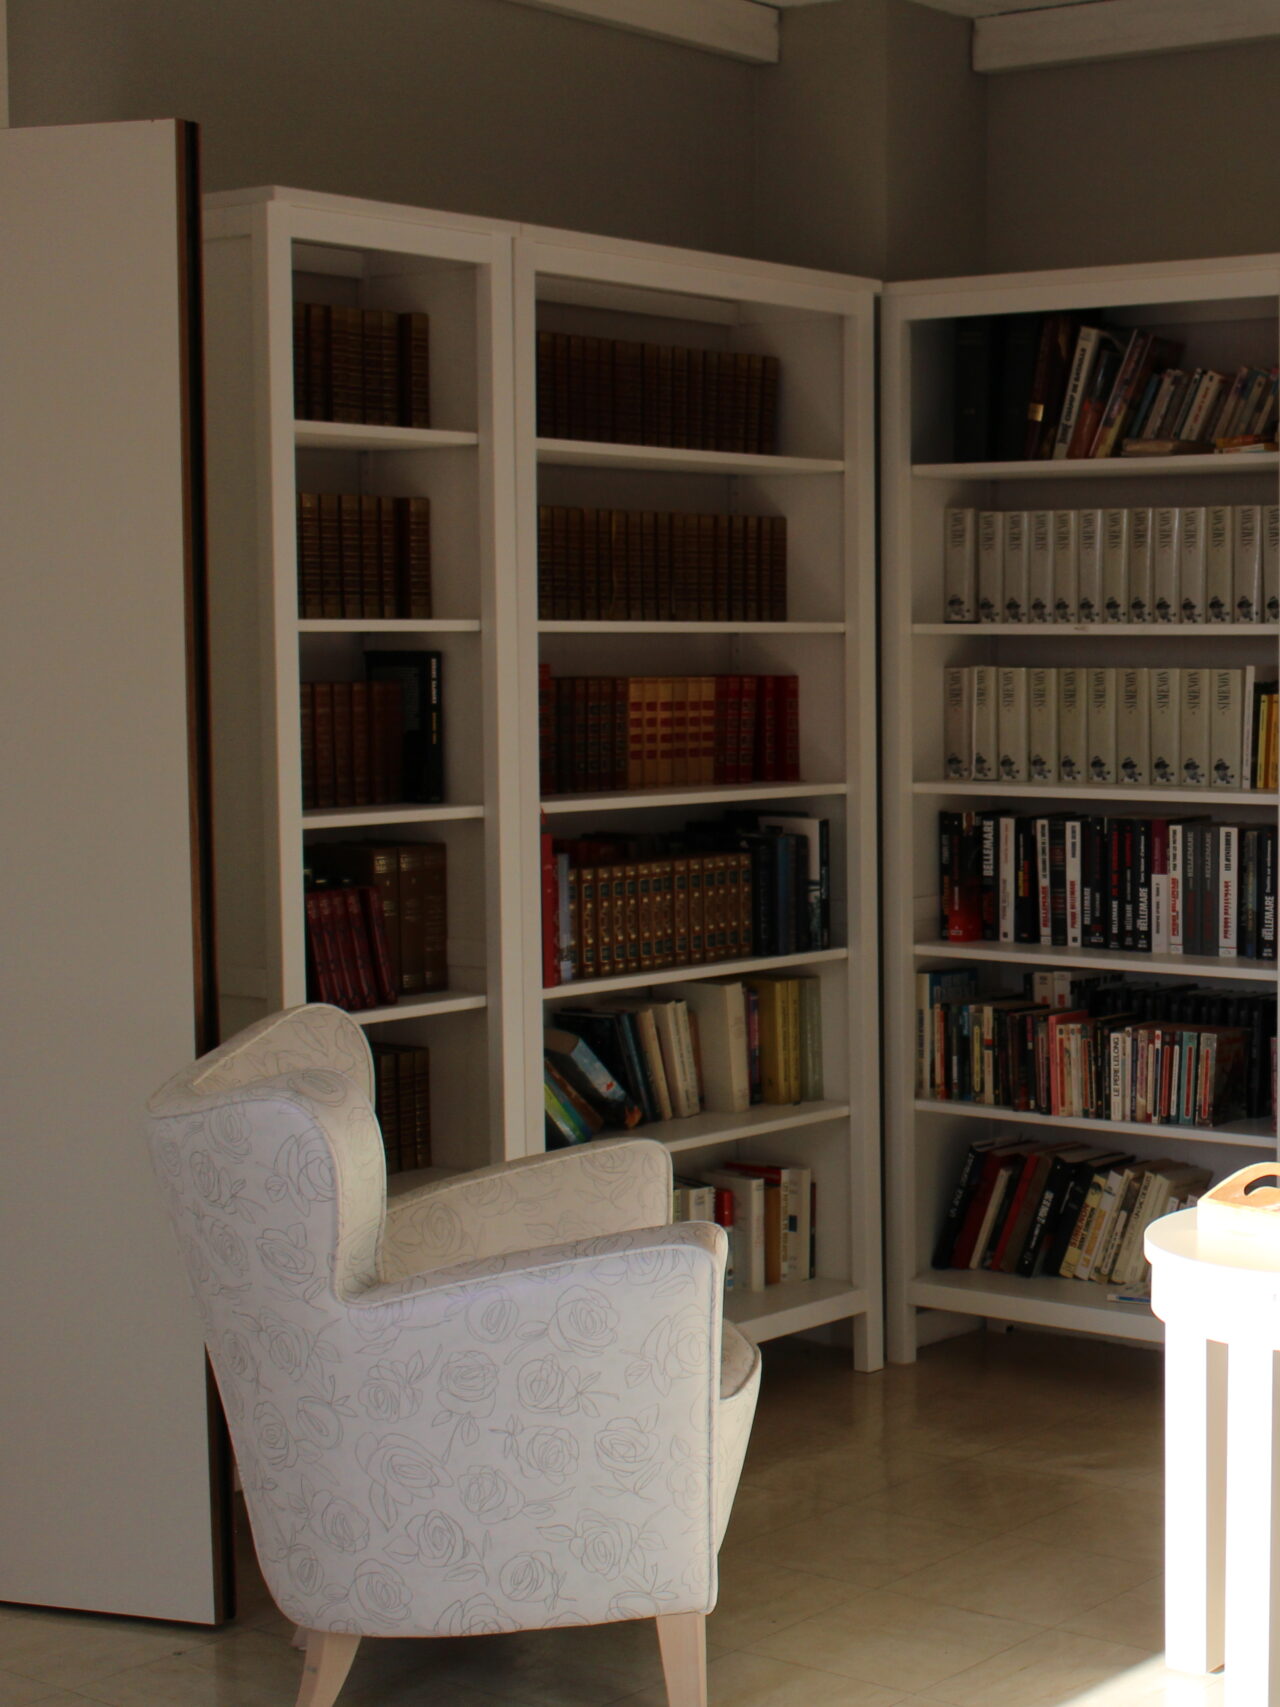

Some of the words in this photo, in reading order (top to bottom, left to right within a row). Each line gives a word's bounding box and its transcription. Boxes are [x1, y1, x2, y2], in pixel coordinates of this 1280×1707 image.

[983, 820, 994, 877] BELLEMARE
[1138, 887, 1148, 932] BELLEMARE
[1264, 896, 1274, 941] BELLEMARE
[1112, 1037, 1120, 1066] LELONG
[1112, 1087, 1120, 1097] LE
[1070, 1203, 1090, 1249] SIMENON
